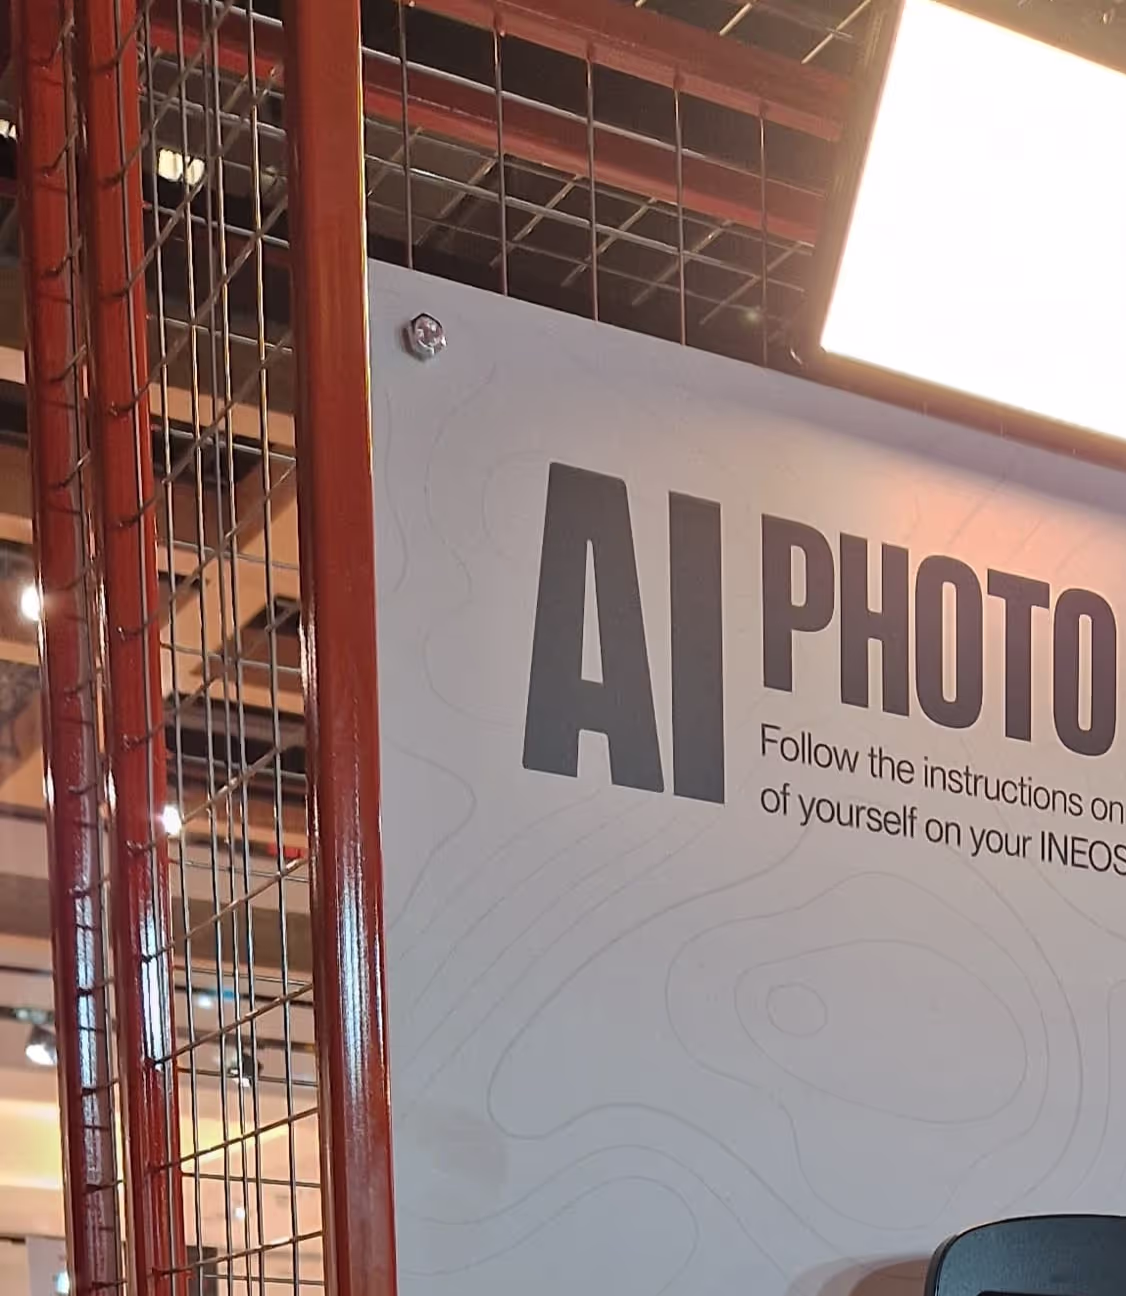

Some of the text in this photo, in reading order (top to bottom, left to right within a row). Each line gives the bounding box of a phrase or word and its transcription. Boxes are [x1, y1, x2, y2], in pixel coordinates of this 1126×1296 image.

[522, 461, 725, 804] AI
[761, 513, 1117, 756] PHOTO
[761, 724, 859, 773] Follow
[868, 747, 914, 784] the
[924, 756, 1083, 817] instructions
[1091, 797, 1124, 825] on
[761, 783, 790, 816] of
[799, 793, 918, 839] yourself
[926, 818, 961, 847] on
[971, 826, 1033, 857] your
